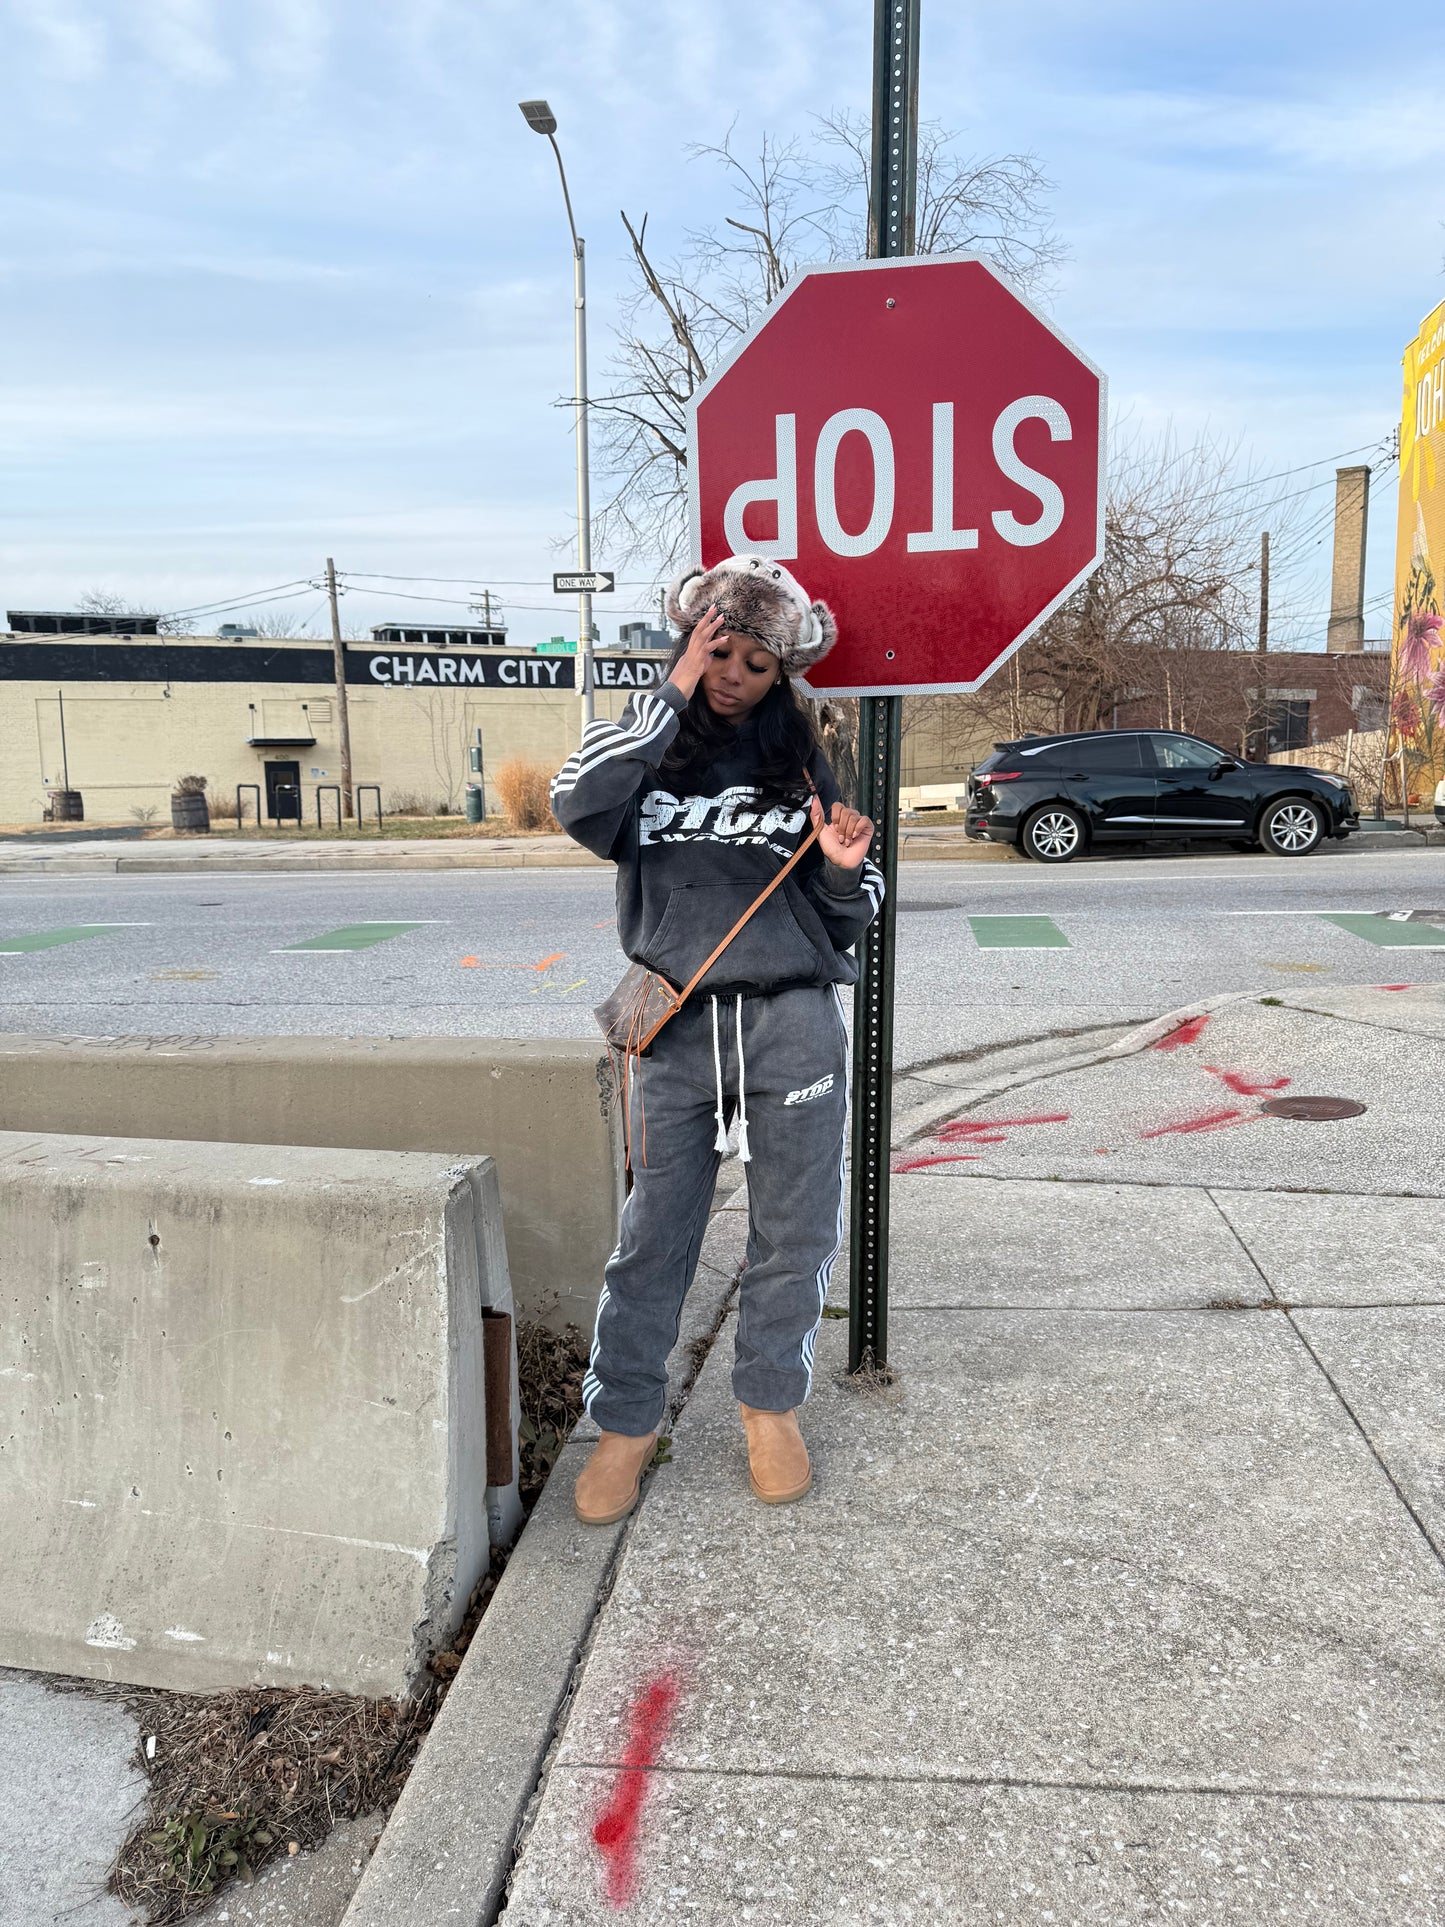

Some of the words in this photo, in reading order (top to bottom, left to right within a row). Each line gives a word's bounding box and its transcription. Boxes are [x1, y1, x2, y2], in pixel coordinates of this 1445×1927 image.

[723, 394, 1073, 561] STOP
[560, 579, 576, 587] ONE
[579, 578, 596, 587] WAY
[369, 655, 486, 684] CHARM
[497, 659, 562, 685] CITY
[784, 1073, 834, 1105] STOP
